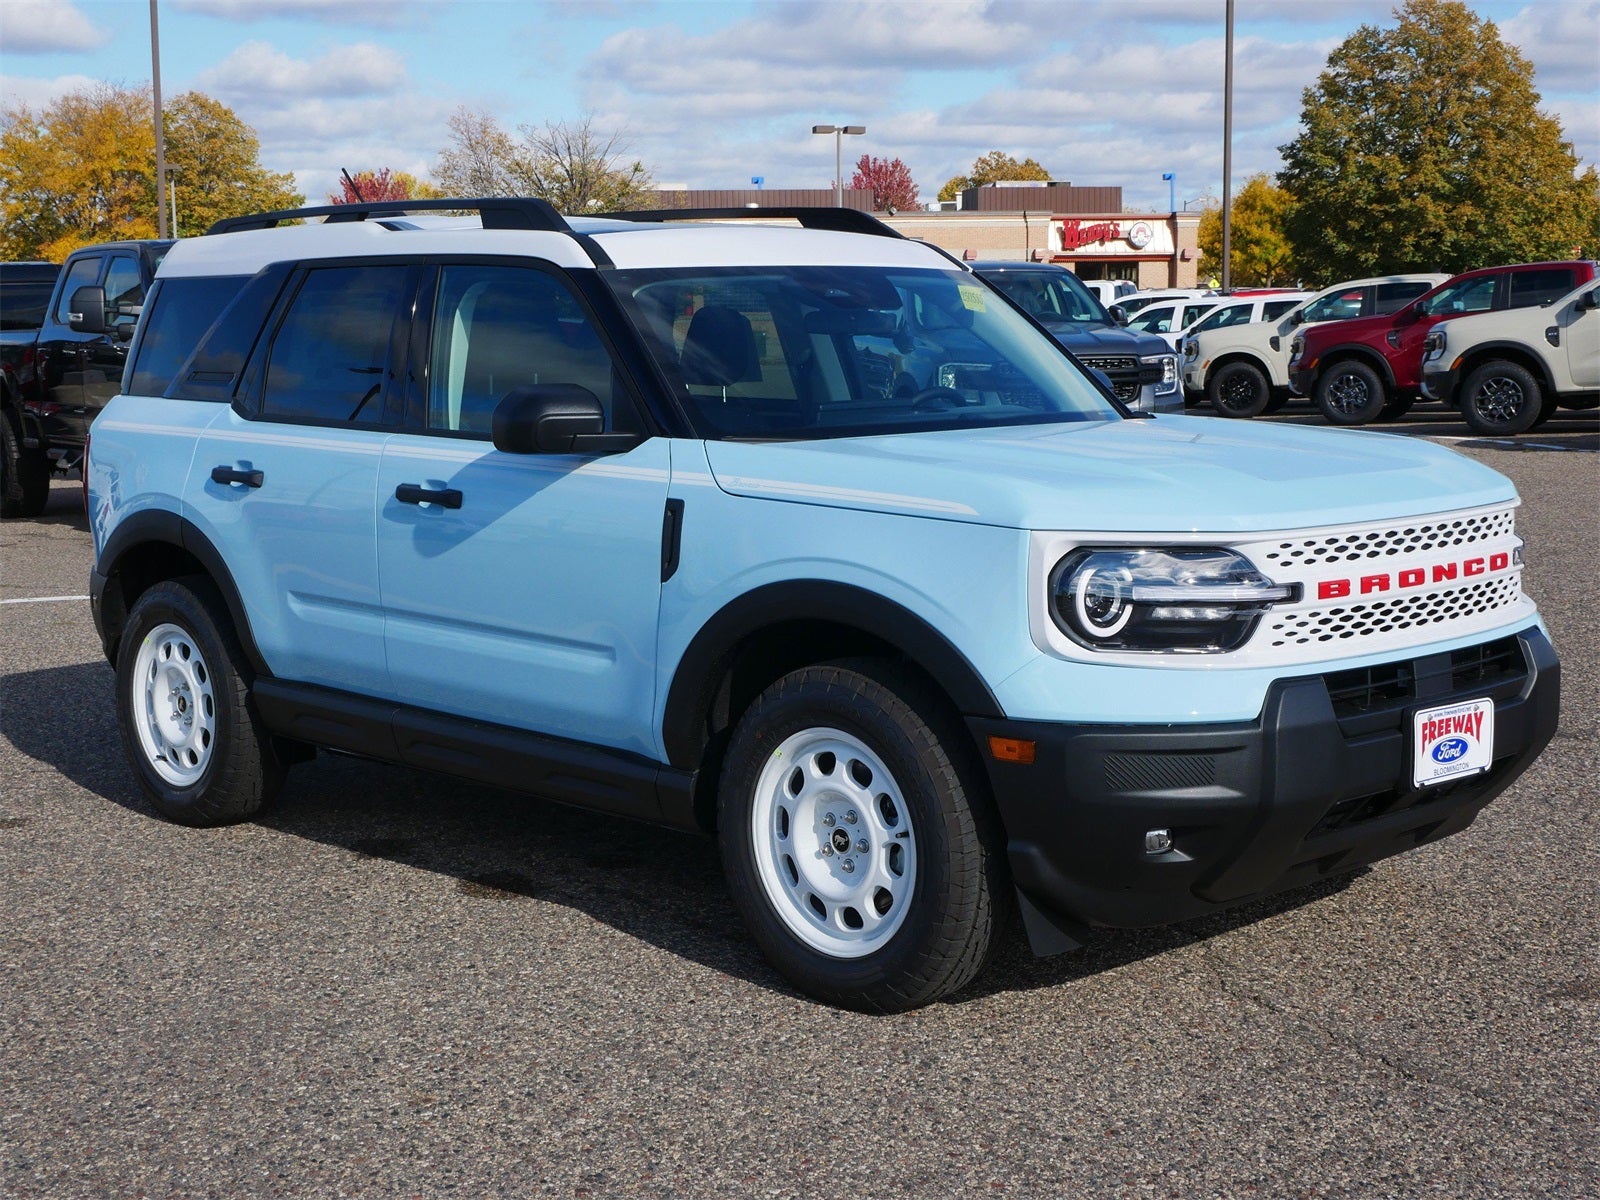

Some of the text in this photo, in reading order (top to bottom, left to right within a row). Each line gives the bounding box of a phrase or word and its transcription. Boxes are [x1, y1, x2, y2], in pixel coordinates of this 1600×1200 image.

[1063, 219, 1120, 249] Wendy's
[1317, 552, 1509, 600] BRONCO
[1421, 711, 1484, 758] FREEWAY
[1437, 740, 1463, 761] Ford
[1433, 762, 1470, 776] BLOOMINGTON
